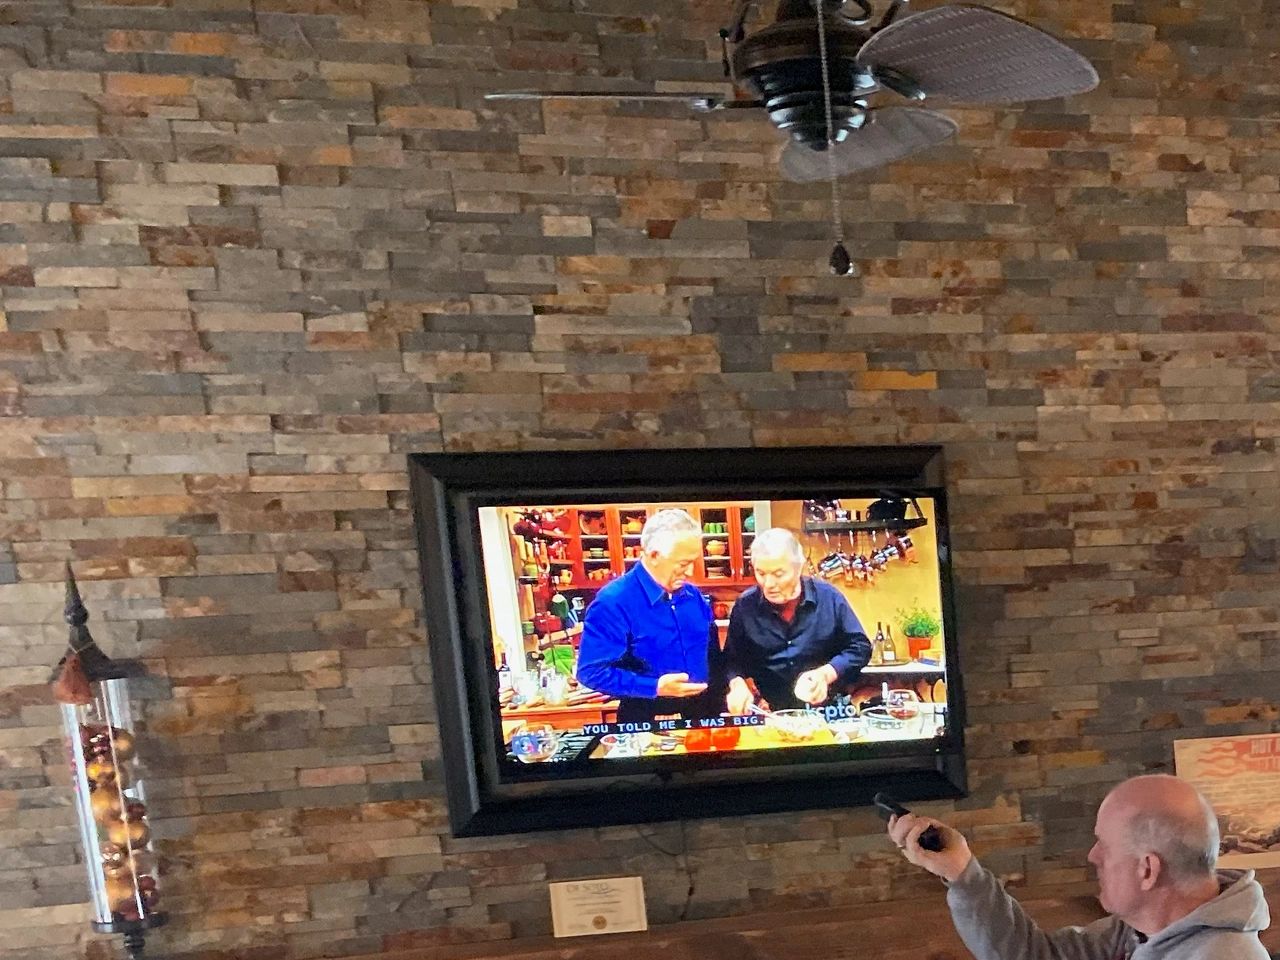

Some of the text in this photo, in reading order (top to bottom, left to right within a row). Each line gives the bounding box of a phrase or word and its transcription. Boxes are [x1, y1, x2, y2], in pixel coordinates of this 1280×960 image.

[584, 716, 764, 735] YOU TOLD ME I WAS BIG.
